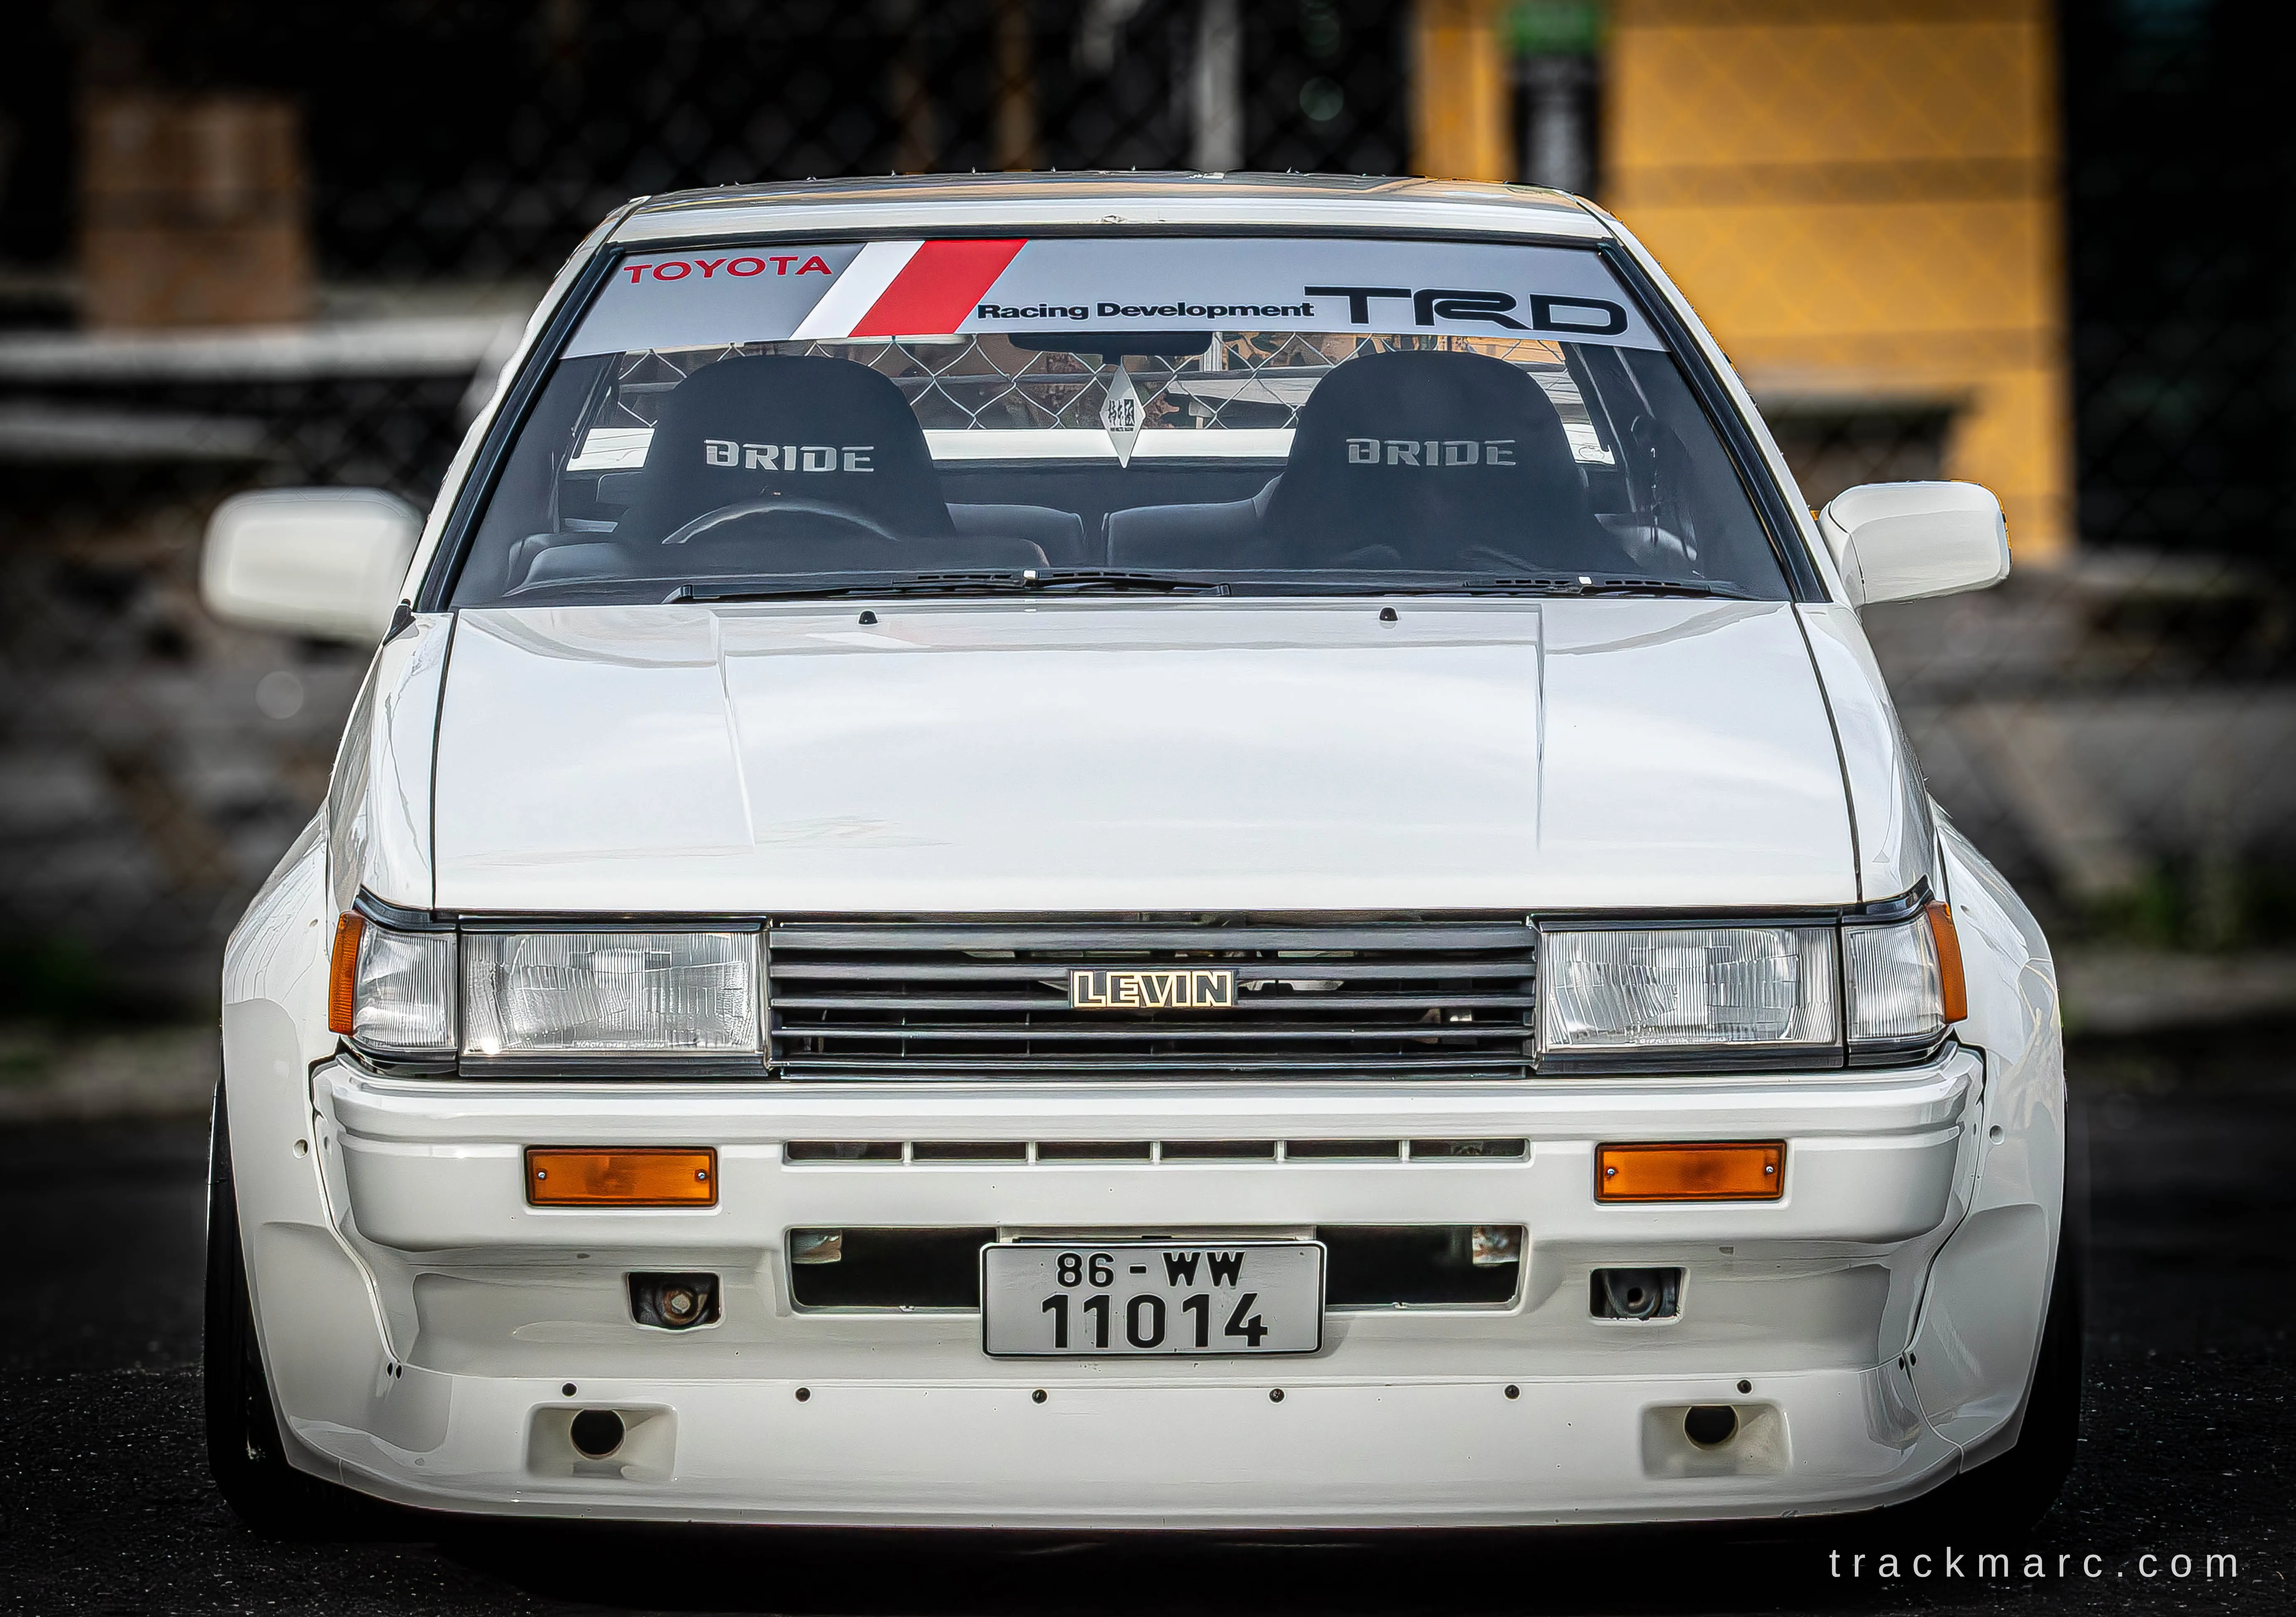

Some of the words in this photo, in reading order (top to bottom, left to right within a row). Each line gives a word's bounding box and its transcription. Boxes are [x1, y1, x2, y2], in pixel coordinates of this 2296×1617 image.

[624, 255, 832, 284] TOYOTA
[977, 304, 1089, 320] Racing
[1097, 302, 1315, 320] Development
[1304, 286, 1628, 336] TRD
[704, 439, 874, 472] BRIDE
[1346, 438, 1517, 467] BRIDE
[1073, 971, 1232, 1007] LEVIN
[1041, 1293, 1269, 1349] 11014
